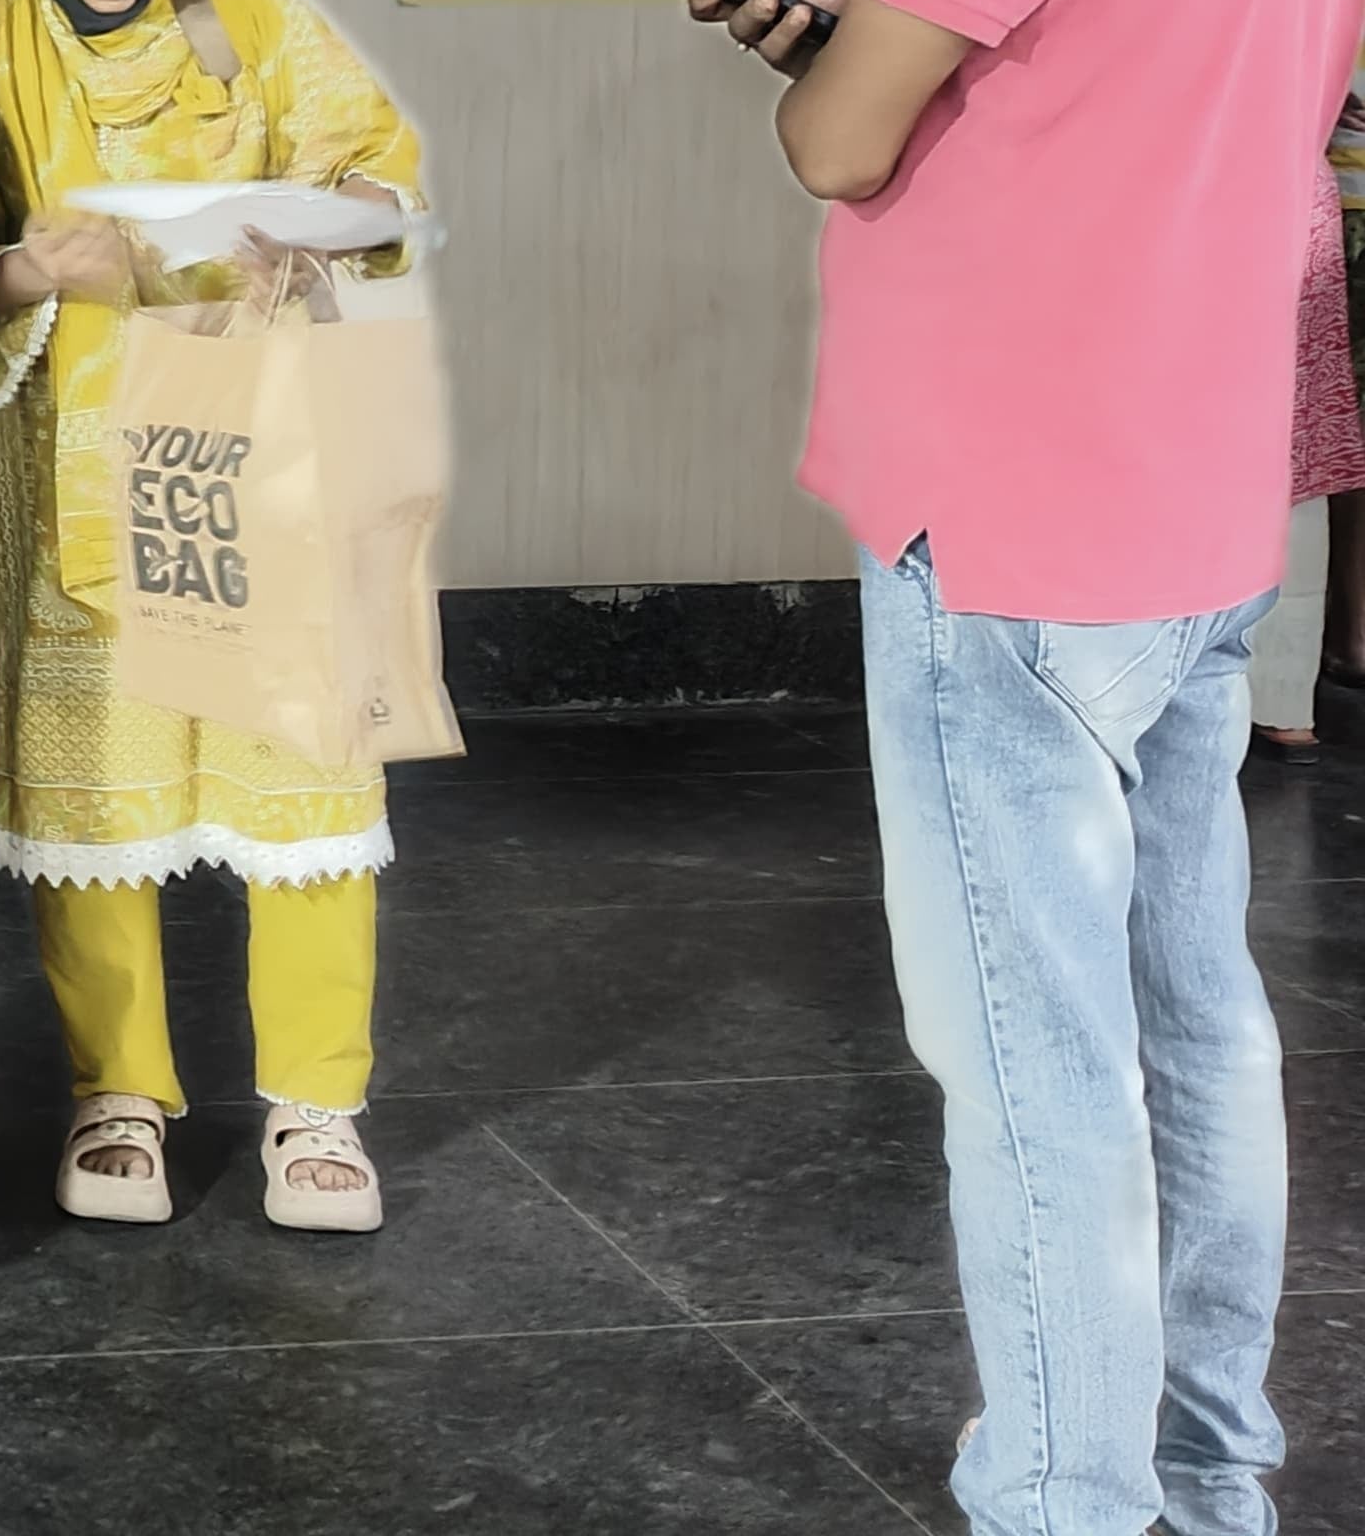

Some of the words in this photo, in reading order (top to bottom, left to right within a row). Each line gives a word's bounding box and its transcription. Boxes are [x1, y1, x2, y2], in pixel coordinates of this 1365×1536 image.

[134, 423, 251, 478] YOUR
[131, 467, 239, 542] ECO
[131, 531, 250, 609] BAG
